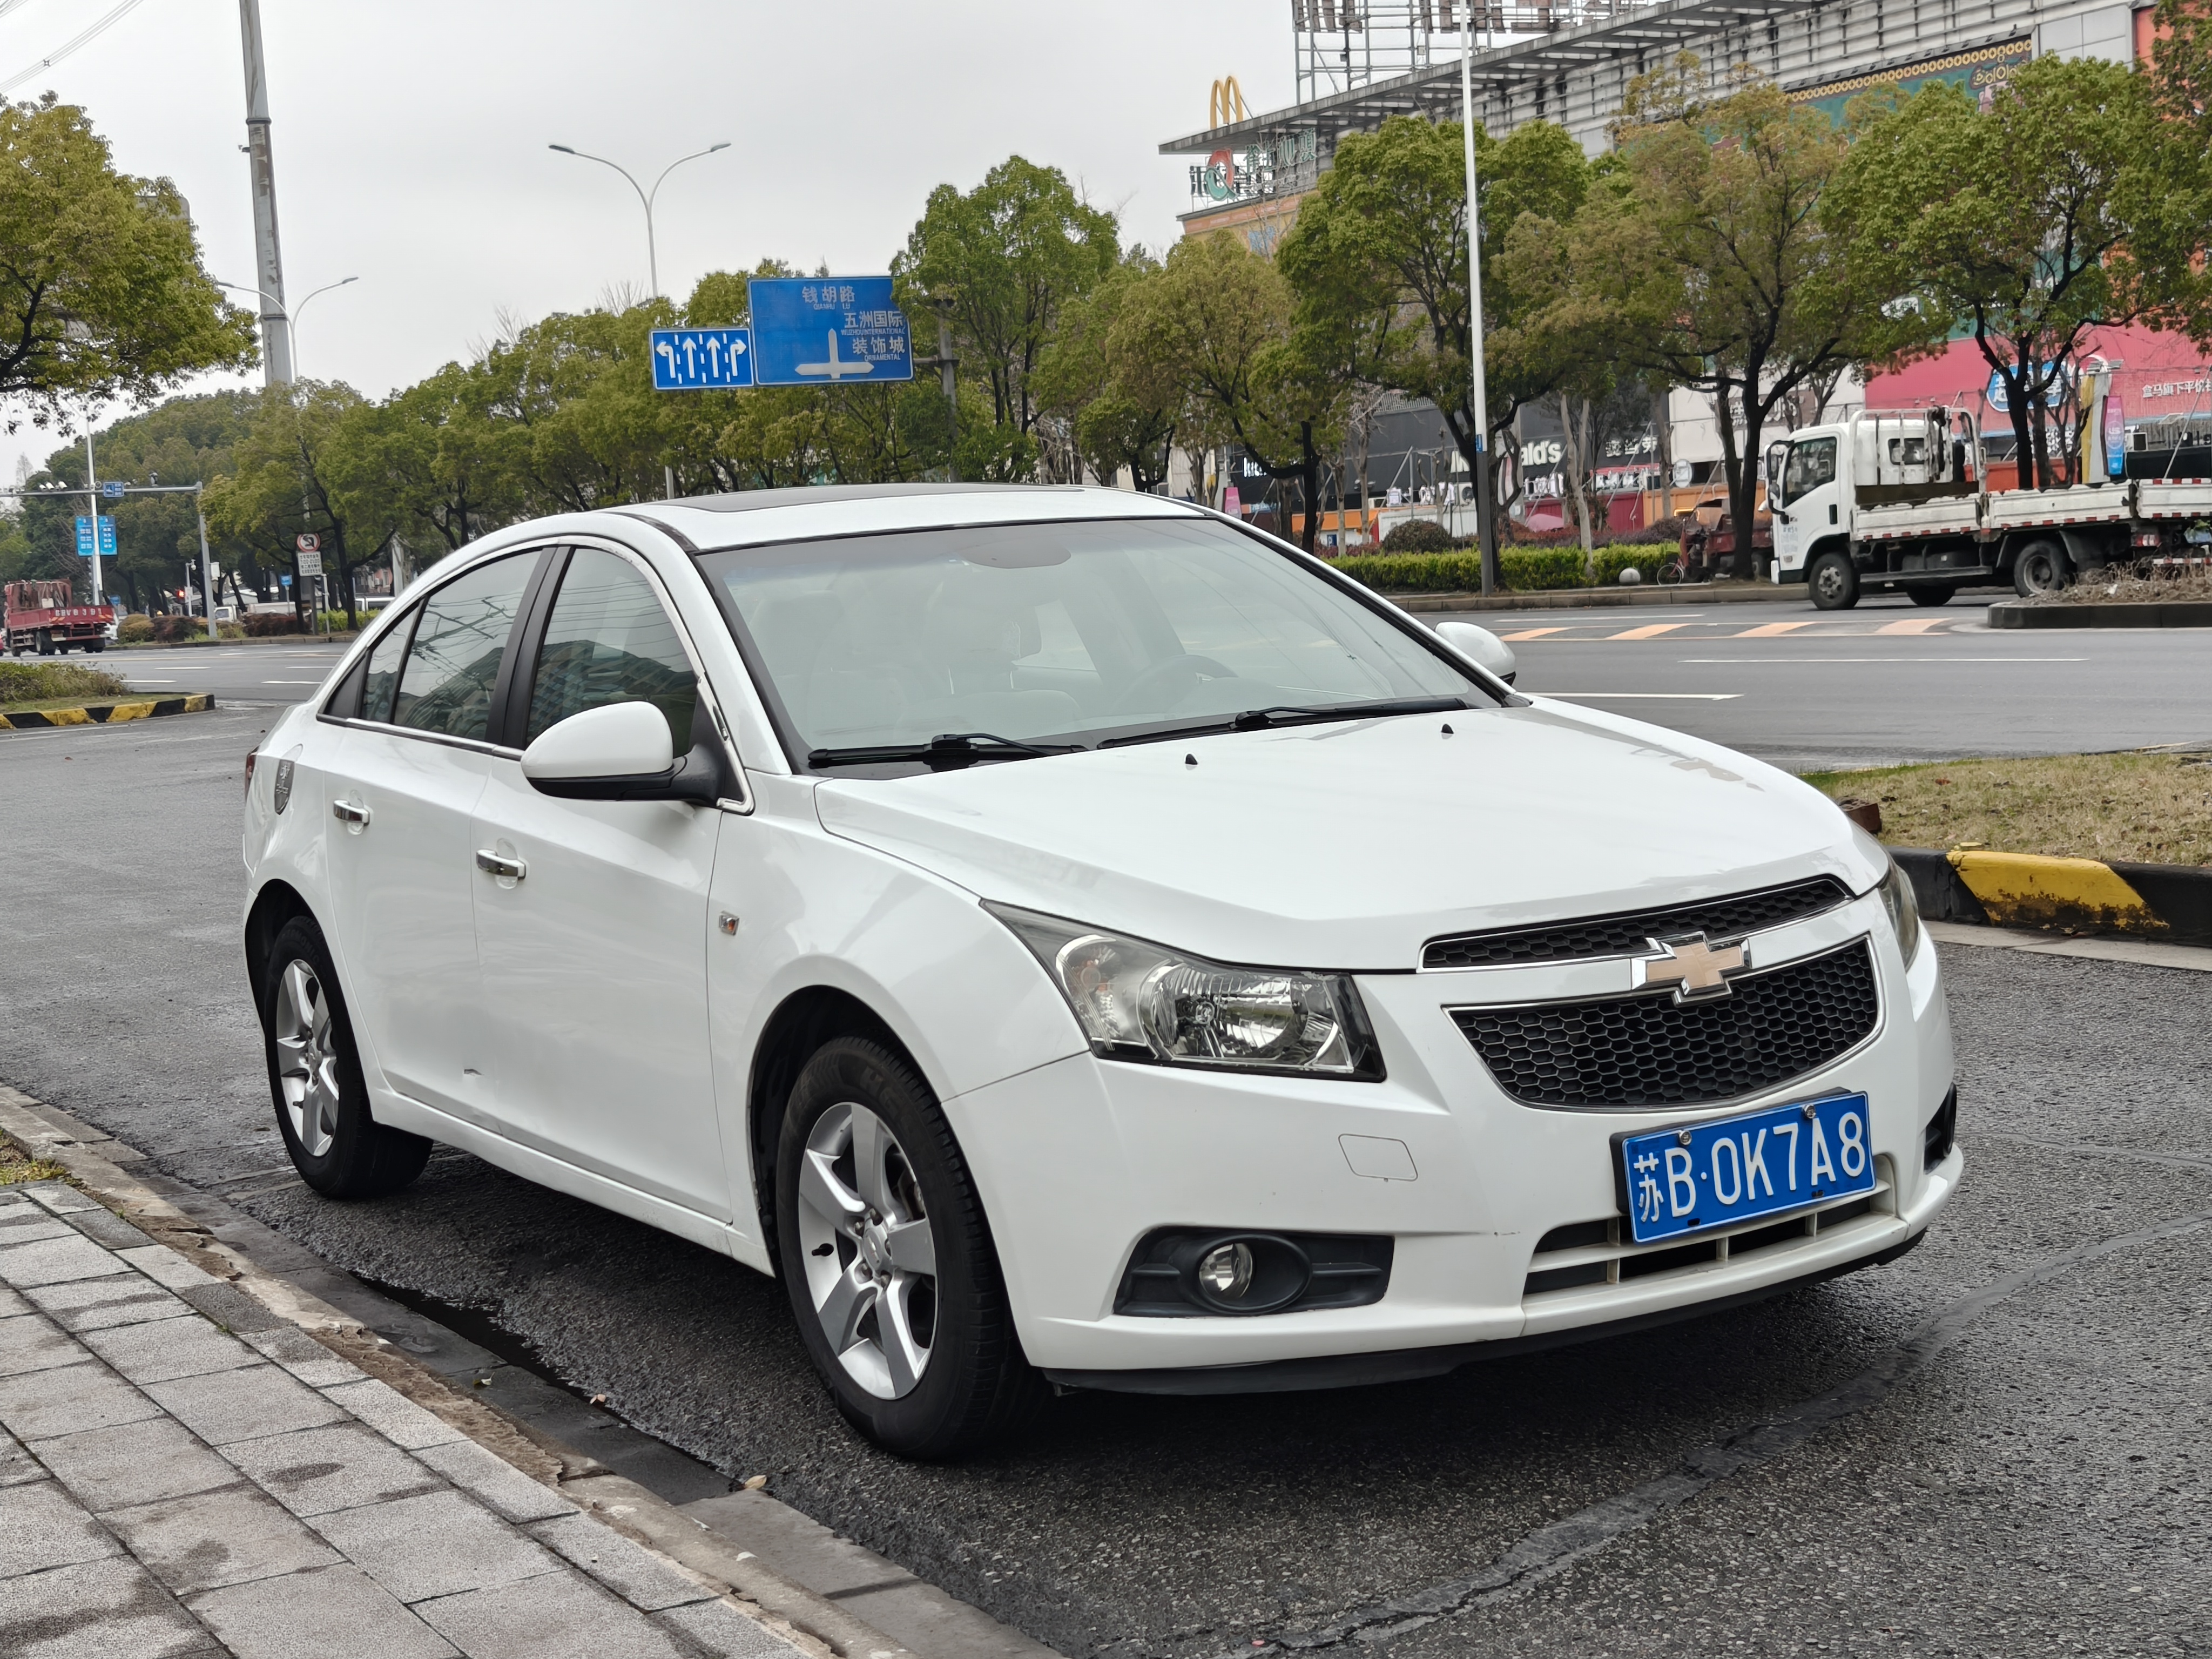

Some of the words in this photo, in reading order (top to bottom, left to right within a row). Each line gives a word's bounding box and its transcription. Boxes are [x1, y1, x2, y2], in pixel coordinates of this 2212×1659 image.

[802, 286, 855, 304] 钱胡路
[844, 311, 903, 328] 五洲国际
[852, 336, 905, 354] 装饰城
[1633, 1111, 1866, 1223] 苏B·0K7A8
